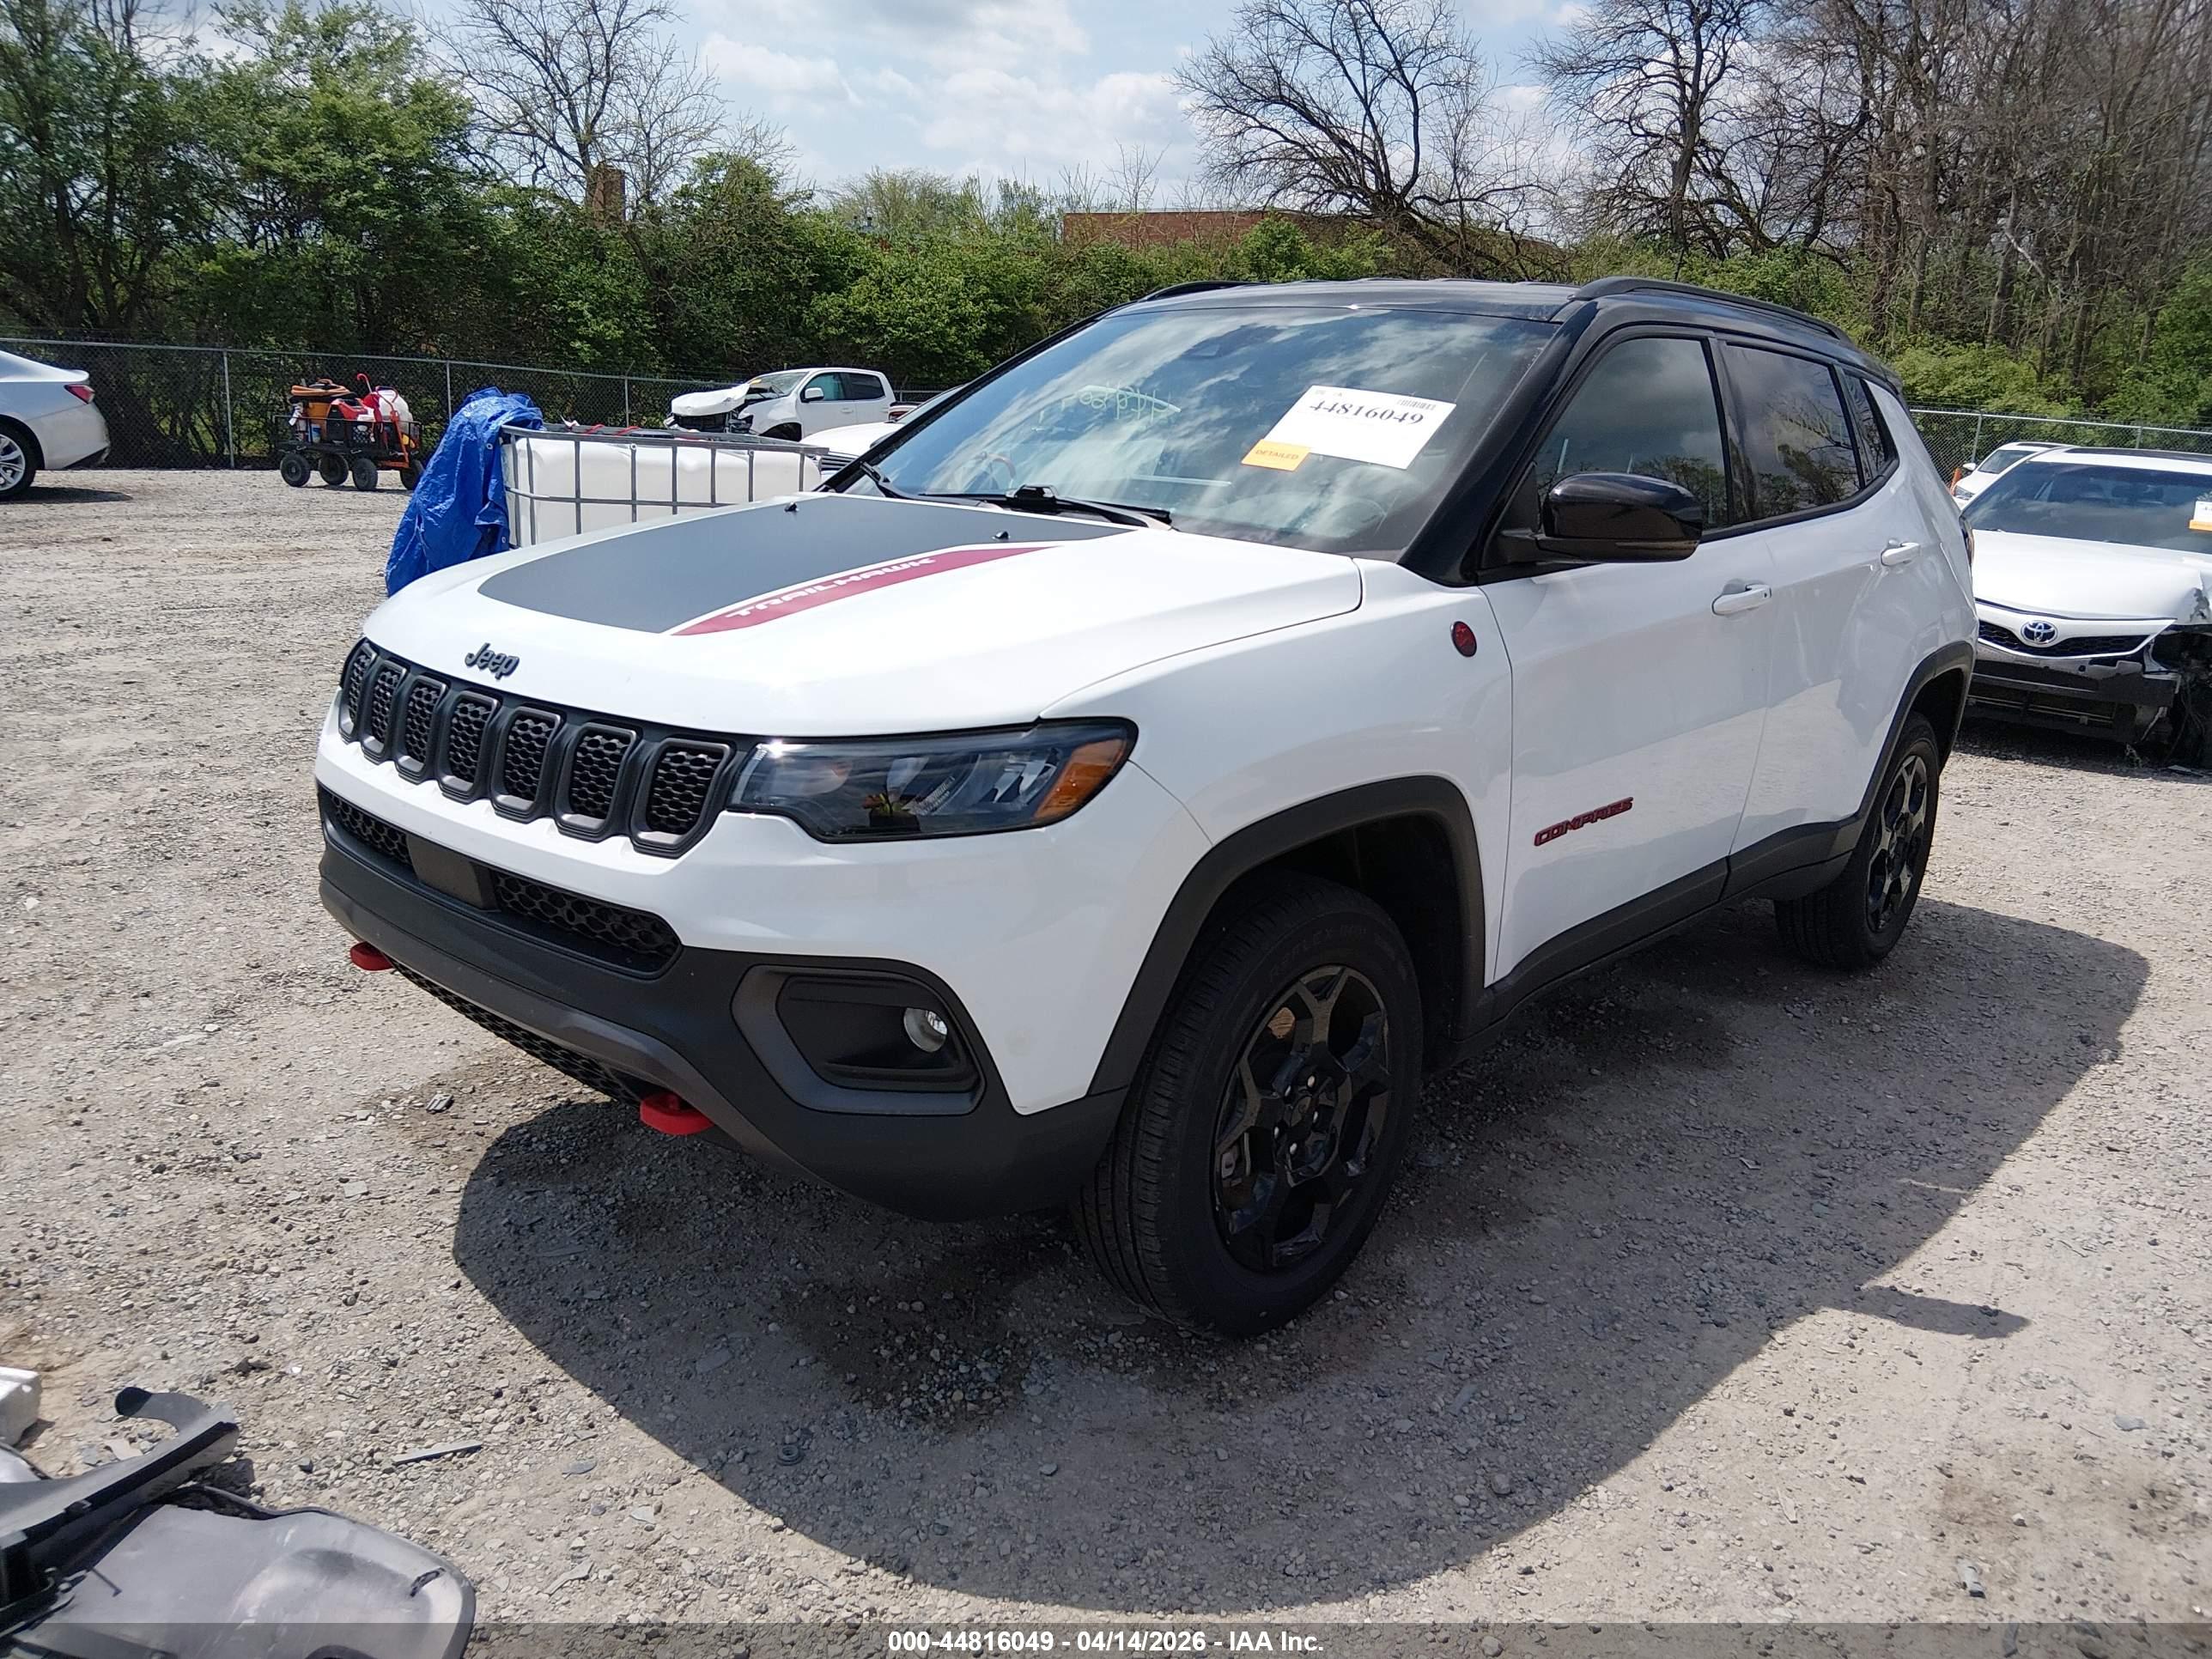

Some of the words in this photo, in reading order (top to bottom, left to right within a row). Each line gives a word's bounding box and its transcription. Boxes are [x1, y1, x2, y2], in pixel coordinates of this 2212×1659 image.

[1309, 399, 1425, 425] 44816049
[1255, 449, 1299, 460] DETAILED
[725, 557, 937, 618] TRAILHAWK
[465, 642, 520, 680] Jeep
[1534, 796, 1634, 847] COMPASS
